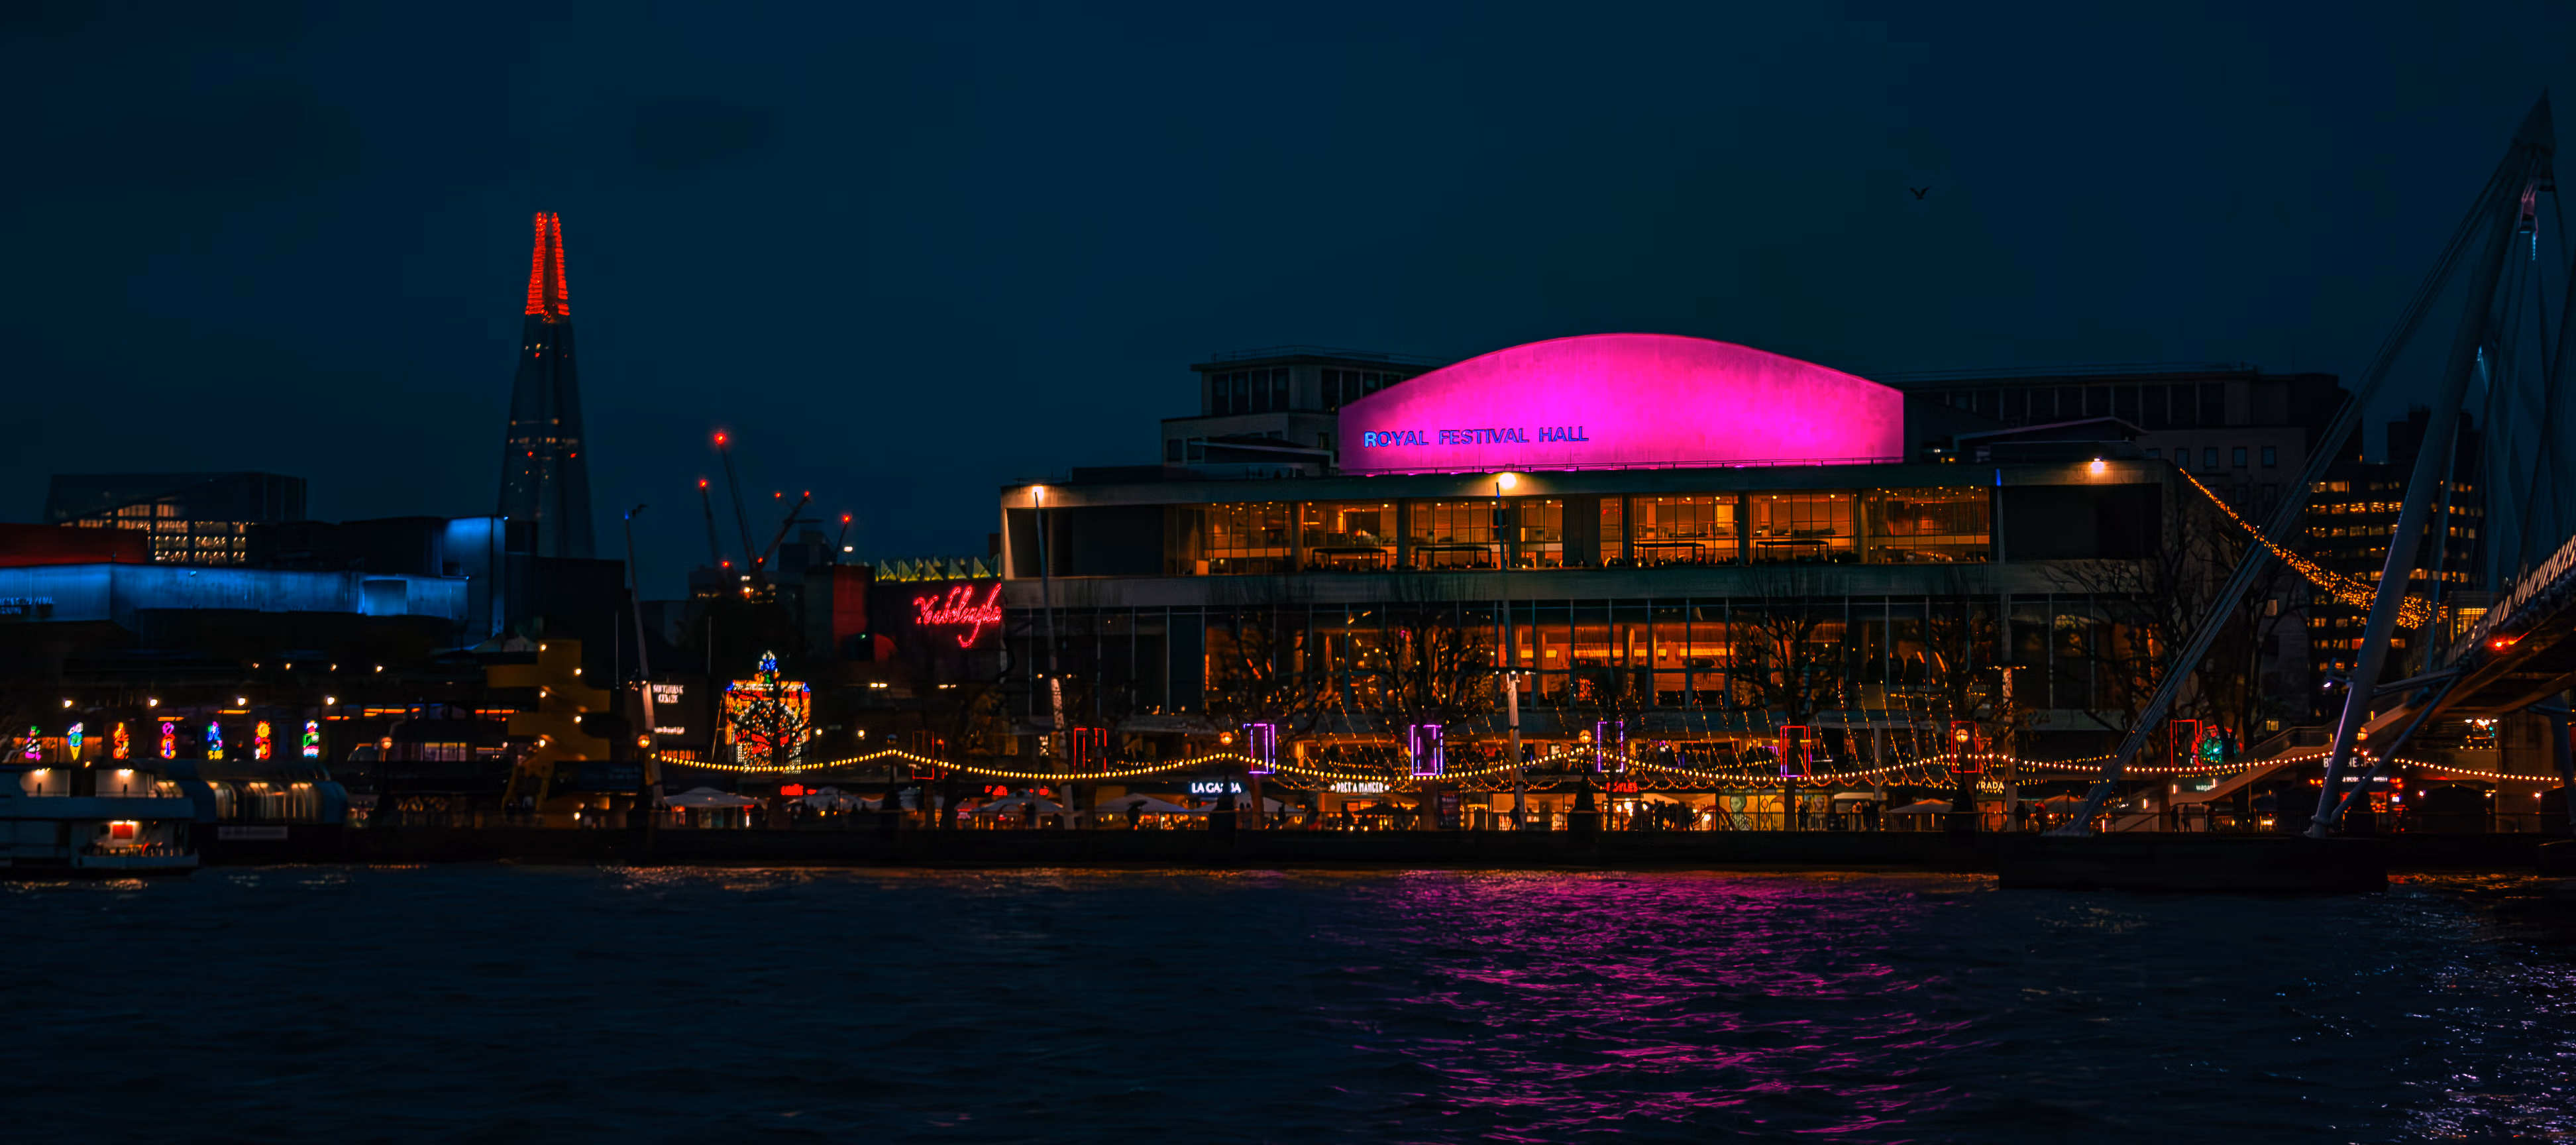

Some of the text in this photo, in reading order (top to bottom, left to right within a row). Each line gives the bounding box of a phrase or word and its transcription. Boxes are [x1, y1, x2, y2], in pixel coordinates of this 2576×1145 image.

[1364, 426, 1589, 447] ROYAL FESTIVAL HALL
[1192, 783, 1242, 793] LA GAA
[1336, 782, 1351, 793] PRET
